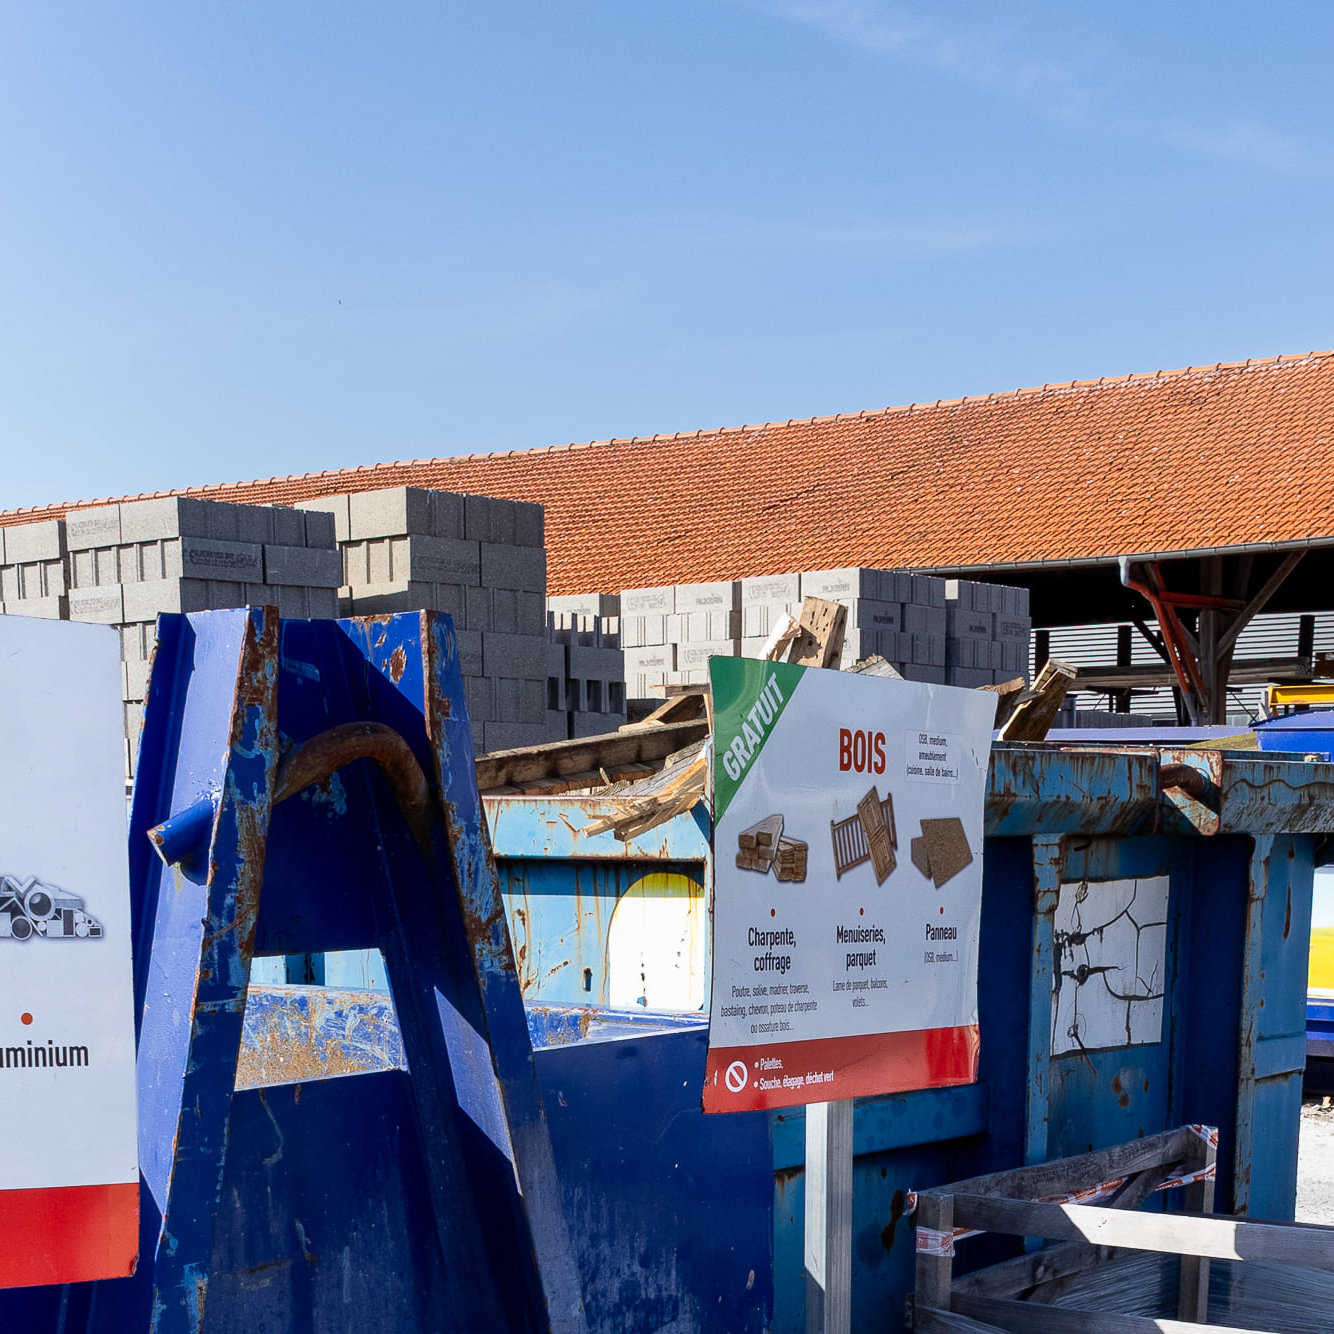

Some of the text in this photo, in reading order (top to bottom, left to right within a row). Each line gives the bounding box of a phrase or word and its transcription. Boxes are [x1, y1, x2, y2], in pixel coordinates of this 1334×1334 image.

[723, 672, 784, 781] GRATUIT
[839, 728, 886, 775] BOIS
[919, 750, 946, 761] ameublement
[925, 766, 934, 776] salle
[935, 766, 941, 776] de
[748, 927, 796, 950] Charpente,
[836, 924, 886, 944] Menuiseries,
[925, 923, 957, 941] Panneau
[754, 952, 791, 975] coffrage
[846, 949, 876, 971] parquet
[731, 985, 751, 998] Poutre,
[752, 984, 769, 997] solive,
[789, 983, 809, 994] traverse,
[832, 980, 845, 991] Lame
[845, 979, 852, 991] de
[721, 1000, 818, 1019] bastaing, chevron, poteau de charpente
[750, 1024, 757, 1034] ou
[758, 1021, 779, 1033] ossature
[759, 1069, 834, 1090] Souche, élagage, déchet vert
